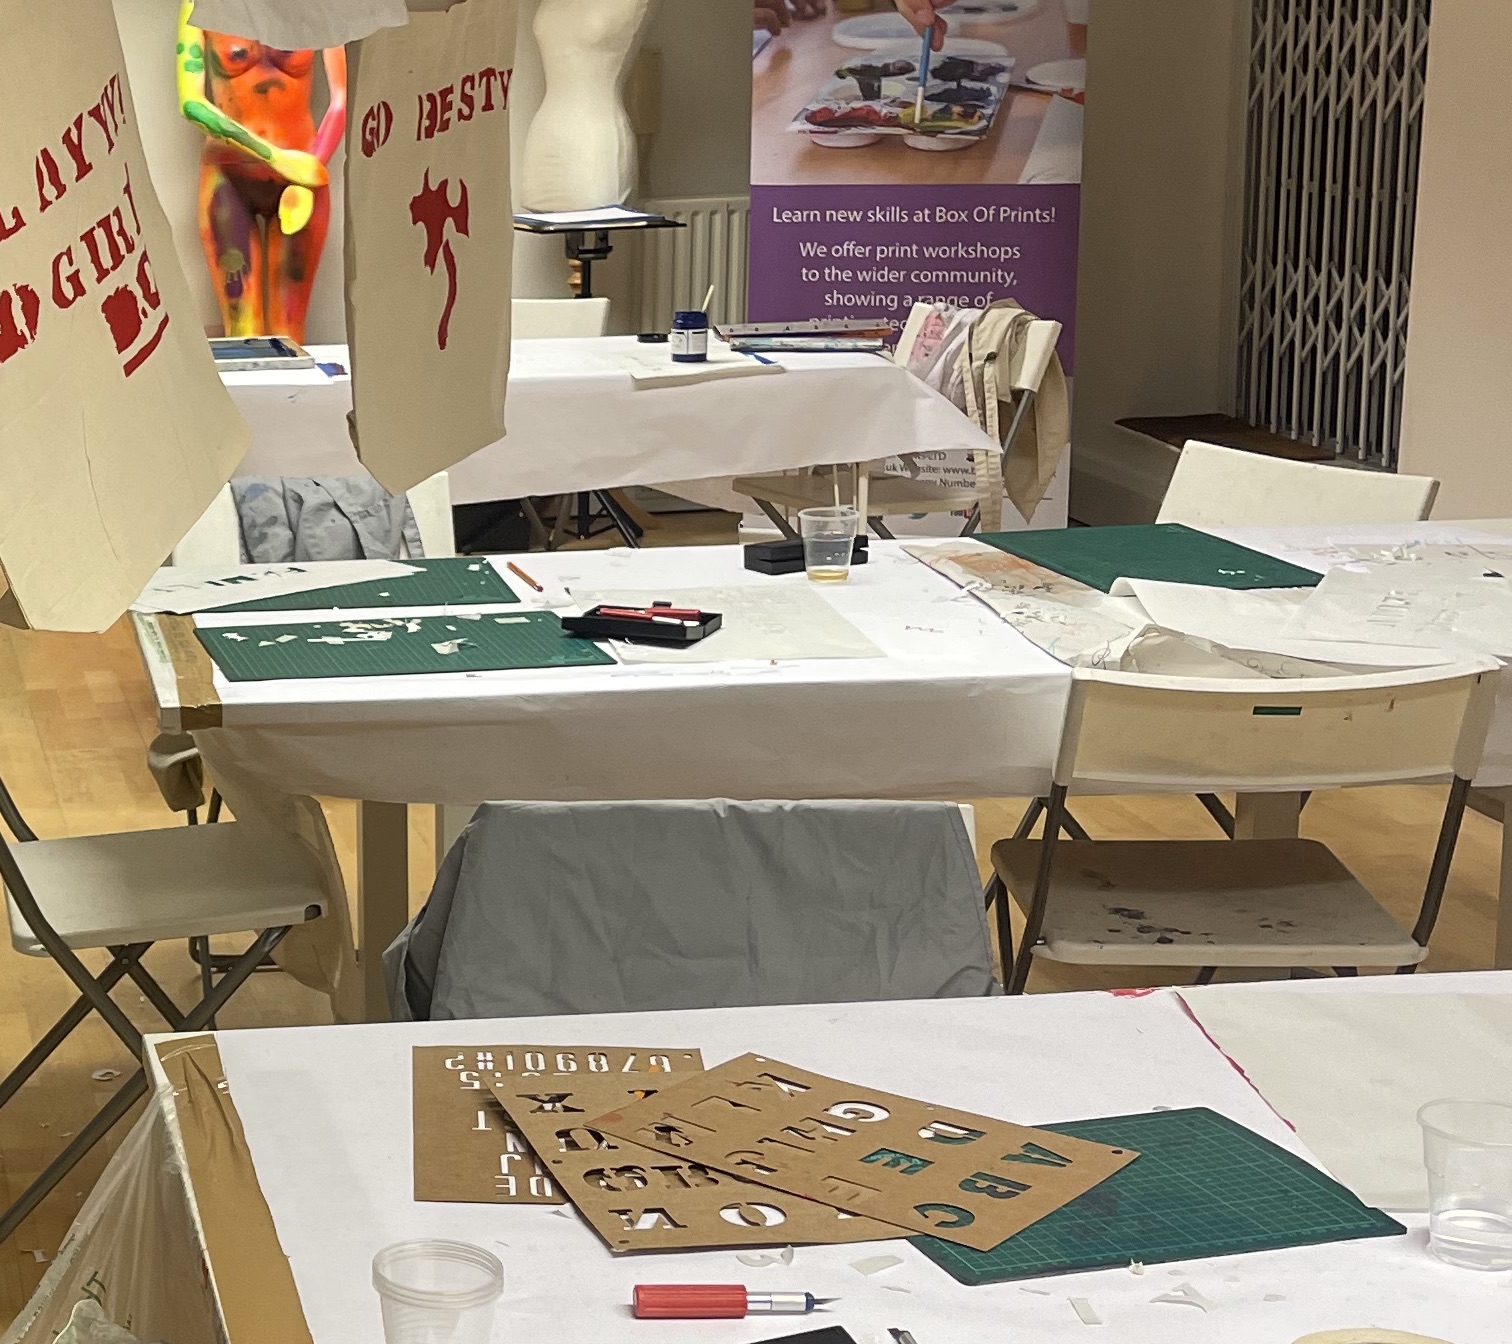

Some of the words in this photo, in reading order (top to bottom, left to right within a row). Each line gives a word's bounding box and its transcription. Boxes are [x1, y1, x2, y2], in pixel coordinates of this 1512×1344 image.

[361, 101, 393, 158] GO
[772, 206, 821, 223] Learn
[825, 209, 863, 223] new
[866, 206, 908, 223] skills
[913, 208, 931, 223] at
[935, 206, 968, 223] Box
[973, 206, 997, 223] Of
[999, 206, 1057, 223] Prints!
[798, 242, 828, 258] We
[831, 241, 871, 258] offer
[876, 242, 918, 262] print
[922, 242, 1021, 262] workshops
[800, 268, 820, 282] to
[824, 266, 853, 282] the
[857, 266, 906, 283] wider
[910, 267, 1018, 288] community,
[824, 291, 898, 311] showing
[902, 294, 914, 307] a
[973, 292, 993, 307] of
[939, 478, 977, 488] Numbe
